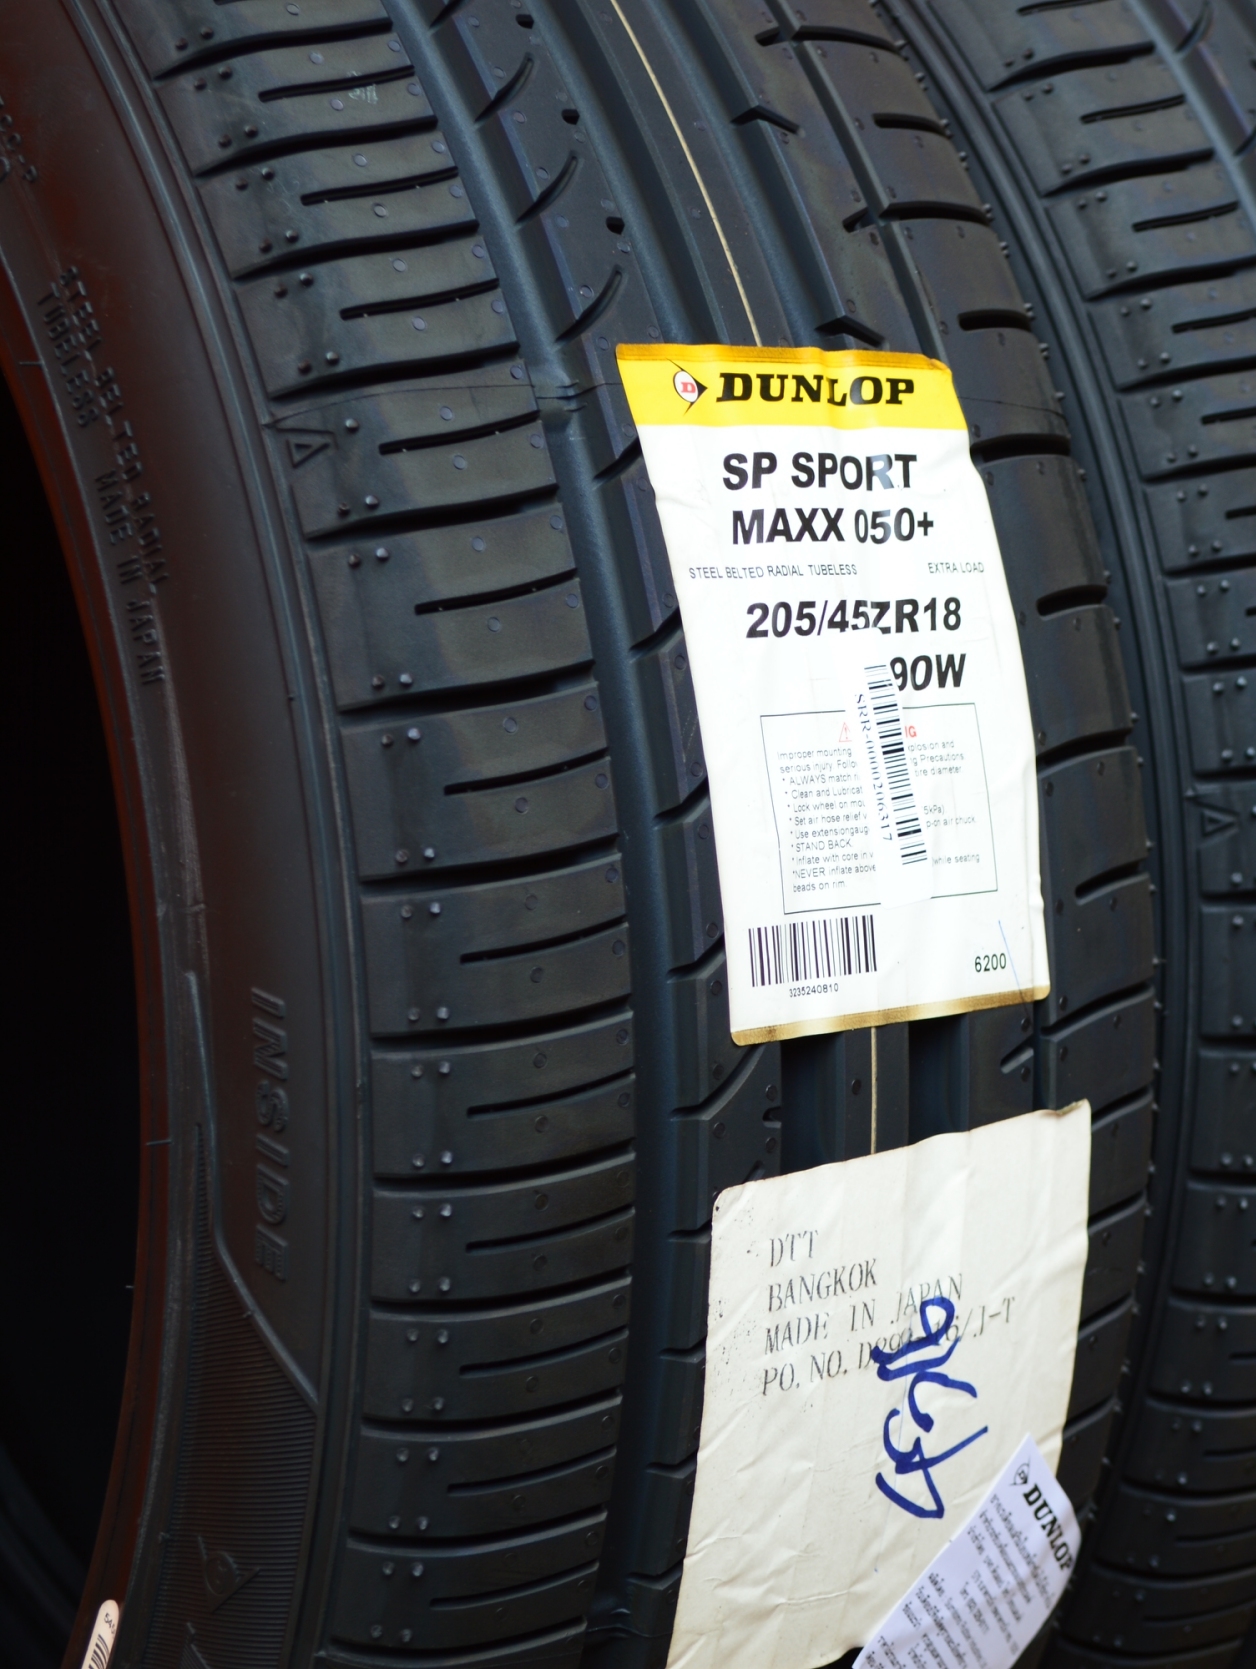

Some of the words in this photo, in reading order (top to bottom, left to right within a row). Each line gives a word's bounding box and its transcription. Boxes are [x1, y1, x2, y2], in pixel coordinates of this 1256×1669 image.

[37, 280, 100, 428] TUBELESS
[716, 372, 915, 406] DUNLOP
[723, 452, 778, 491] SP
[791, 451, 917, 491] SPORT
[94, 468, 134, 545] MADE
[732, 507, 845, 545] MAXX
[854, 507, 936, 545] 050+
[117, 555, 143, 585] IN
[689, 566, 724, 580] STEEL
[725, 566, 765, 579] BELTED
[767, 564, 804, 577] RADIAL
[808, 564, 858, 577] TUBELESS
[928, 561, 958, 574] EXTRA
[960, 561, 985, 574] LOAD
[746, 597, 962, 639] 205/45ZR18
[126, 600, 166, 685] JAPAN
[889, 652, 966, 693] 90W
[777, 750, 814, 762] Improper
[817, 747, 852, 758] mounting
[780, 763, 811, 774] serious
[920, 752, 964, 763] Precautions
[789, 774, 826, 786] ALWAYS
[828, 773, 852, 783] match
[791, 788, 814, 799] Clean
[816, 786, 831, 798] and
[793, 801, 811, 813] Lock
[813, 800, 837, 811] wheel
[839, 799, 849, 809] on
[794, 814, 806, 826] Set
[808, 813, 818, 825] air
[821, 812, 840, 824] hose
[795, 828, 809, 840] Use
[795, 840, 825, 853] STAND
[822, 852, 840, 864] with
[842, 851, 858, 862] core
[828, 864, 852, 876] inflate
[819, 880, 830, 891] on
[975, 951, 1007, 973] 6200
[789, 983, 839, 998] 3235240810
[251, 986, 290, 1284] INSIDE
[770, 1230, 819, 1267] DTT
[768, 1258, 877, 1313] BANGKOK
[765, 1312, 830, 1355] MADE
[850, 1299, 876, 1332] IN
[890, 1273, 964, 1325] JAPAN
[763, 1362, 800, 1397] PO.
[810, 1350, 848, 1383] NO.
[1023, 1482, 1073, 1571] DUNLOP
